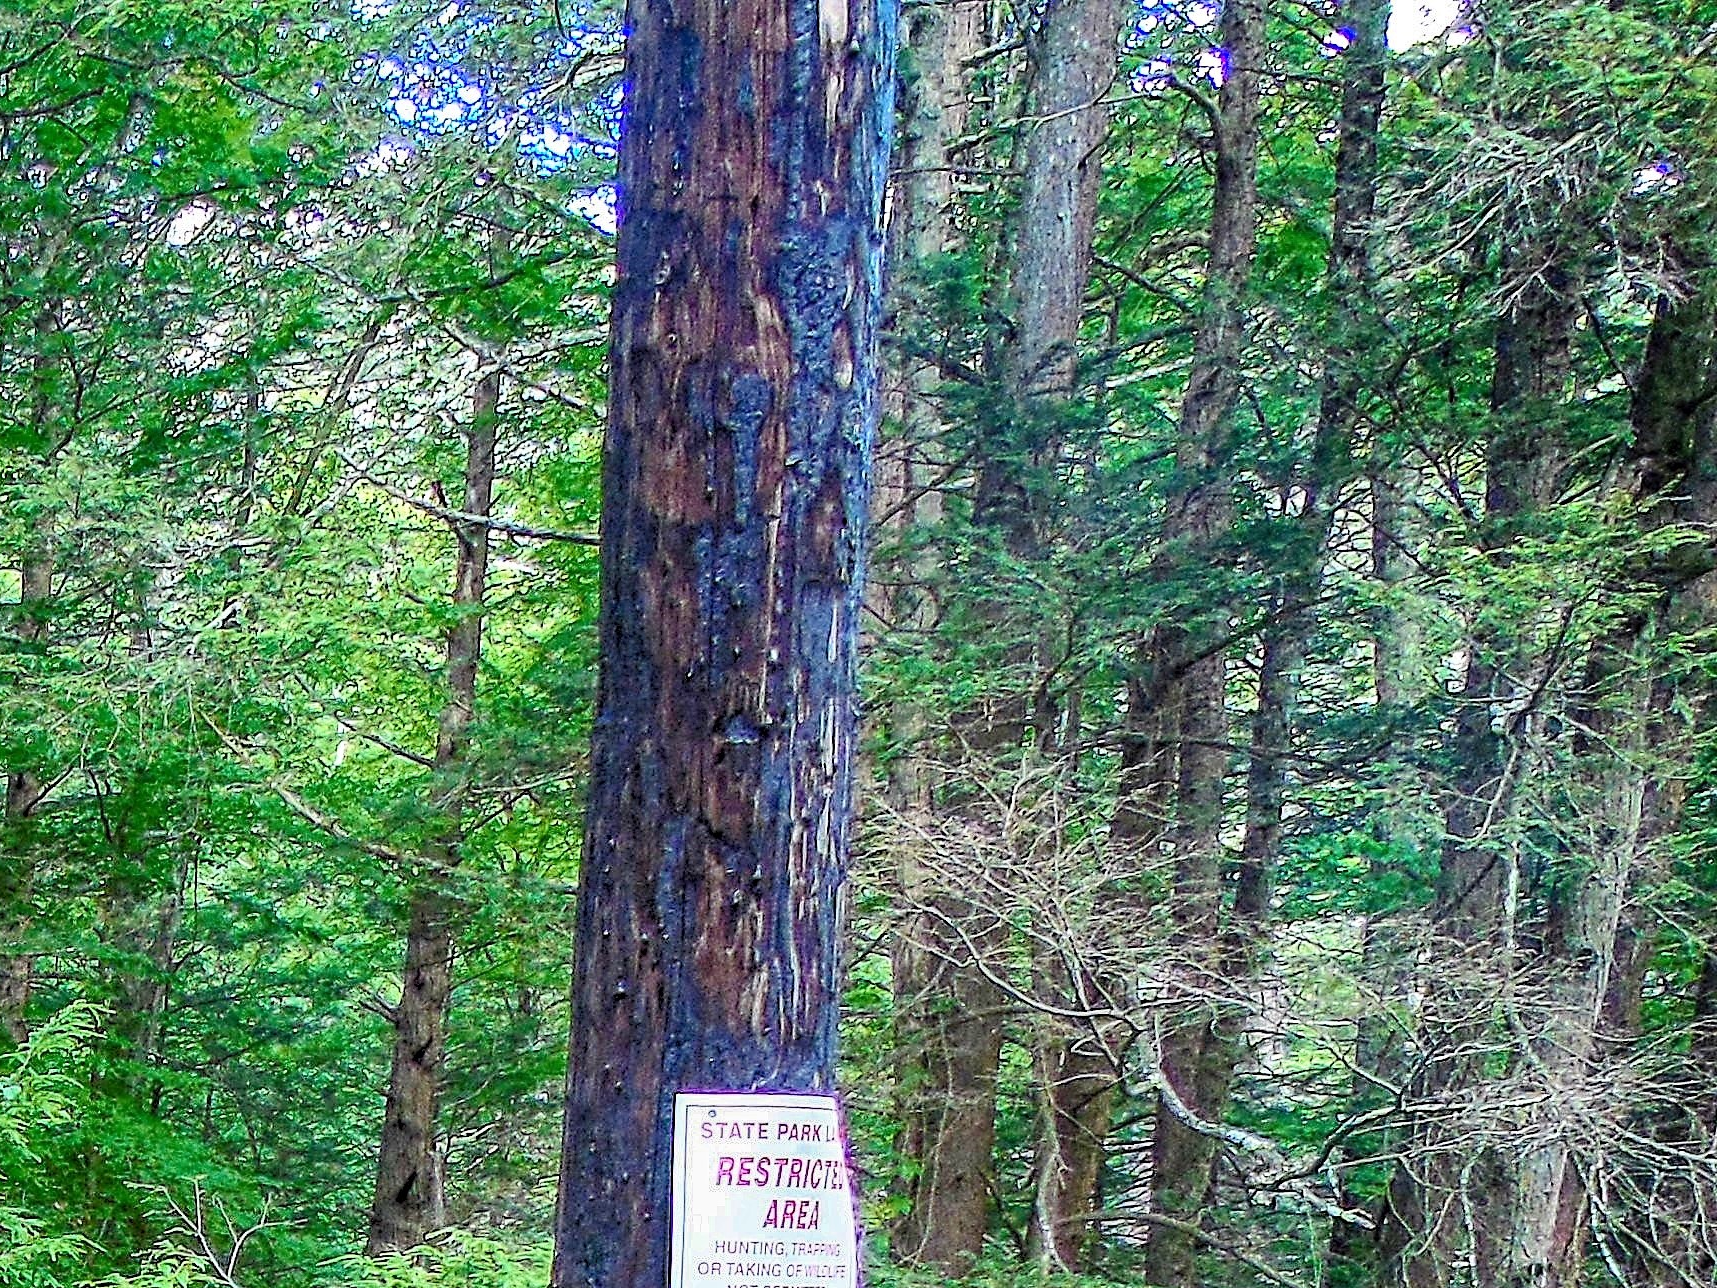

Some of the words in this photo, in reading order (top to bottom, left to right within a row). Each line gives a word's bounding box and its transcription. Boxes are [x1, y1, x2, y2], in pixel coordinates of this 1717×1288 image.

[700, 1121, 769, 1140] STATE
[776, 1122, 822, 1142] PARK
[762, 1198, 821, 1231] AREA
[714, 1240, 789, 1259] HUNTING,
[697, 1261, 722, 1276] OR
[726, 1262, 782, 1278] TAKING
[786, 1263, 803, 1278] OF
